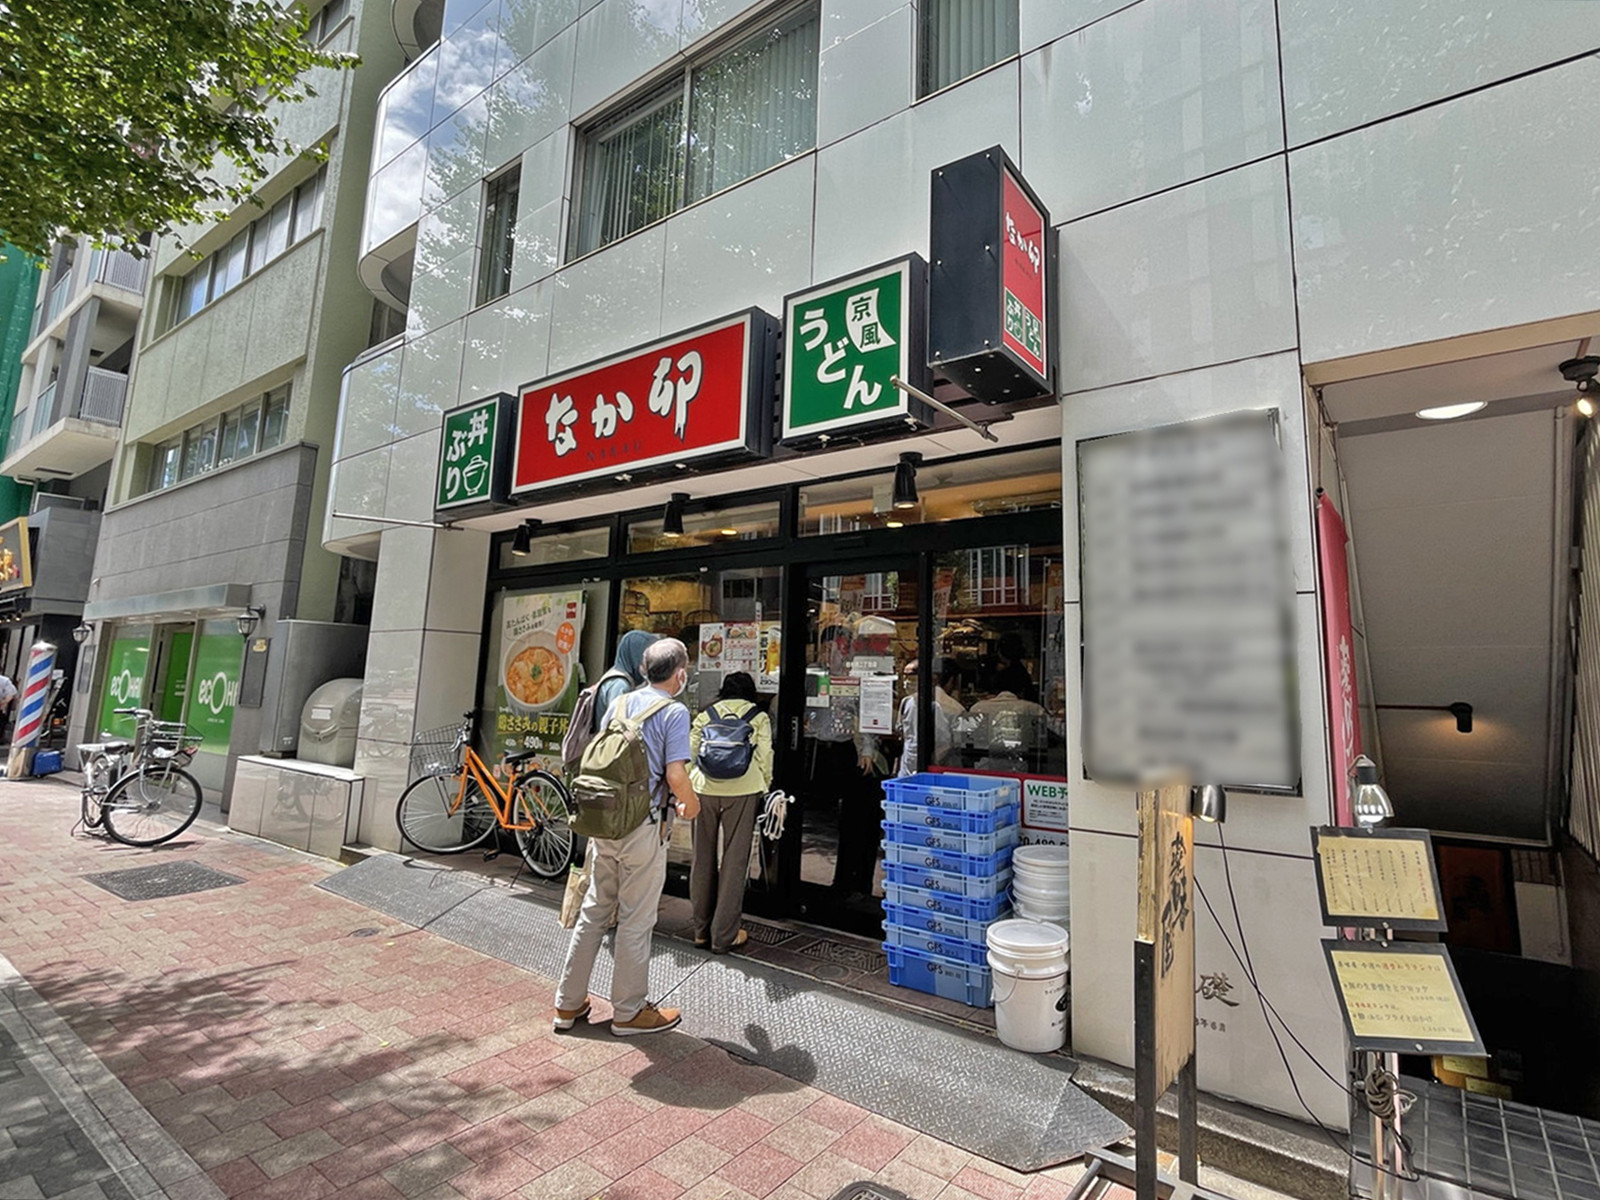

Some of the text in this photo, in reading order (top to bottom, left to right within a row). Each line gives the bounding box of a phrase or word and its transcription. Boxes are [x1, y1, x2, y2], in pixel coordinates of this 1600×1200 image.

[850, 295, 882, 348] 京風
[799, 307, 883, 410] うどん
[545, 350, 703, 457] なか卯
[925, 796, 941, 807] GFS
[925, 816, 941, 827] GFS
[925, 837, 941, 848] GFS
[925, 857, 941, 869] GFS
[924, 878, 940, 890] GFS
[926, 899, 942, 911] GFS
[926, 920, 943, 932] GFS
[927, 941, 943, 954] GFS
[927, 962, 944, 975] GFS
